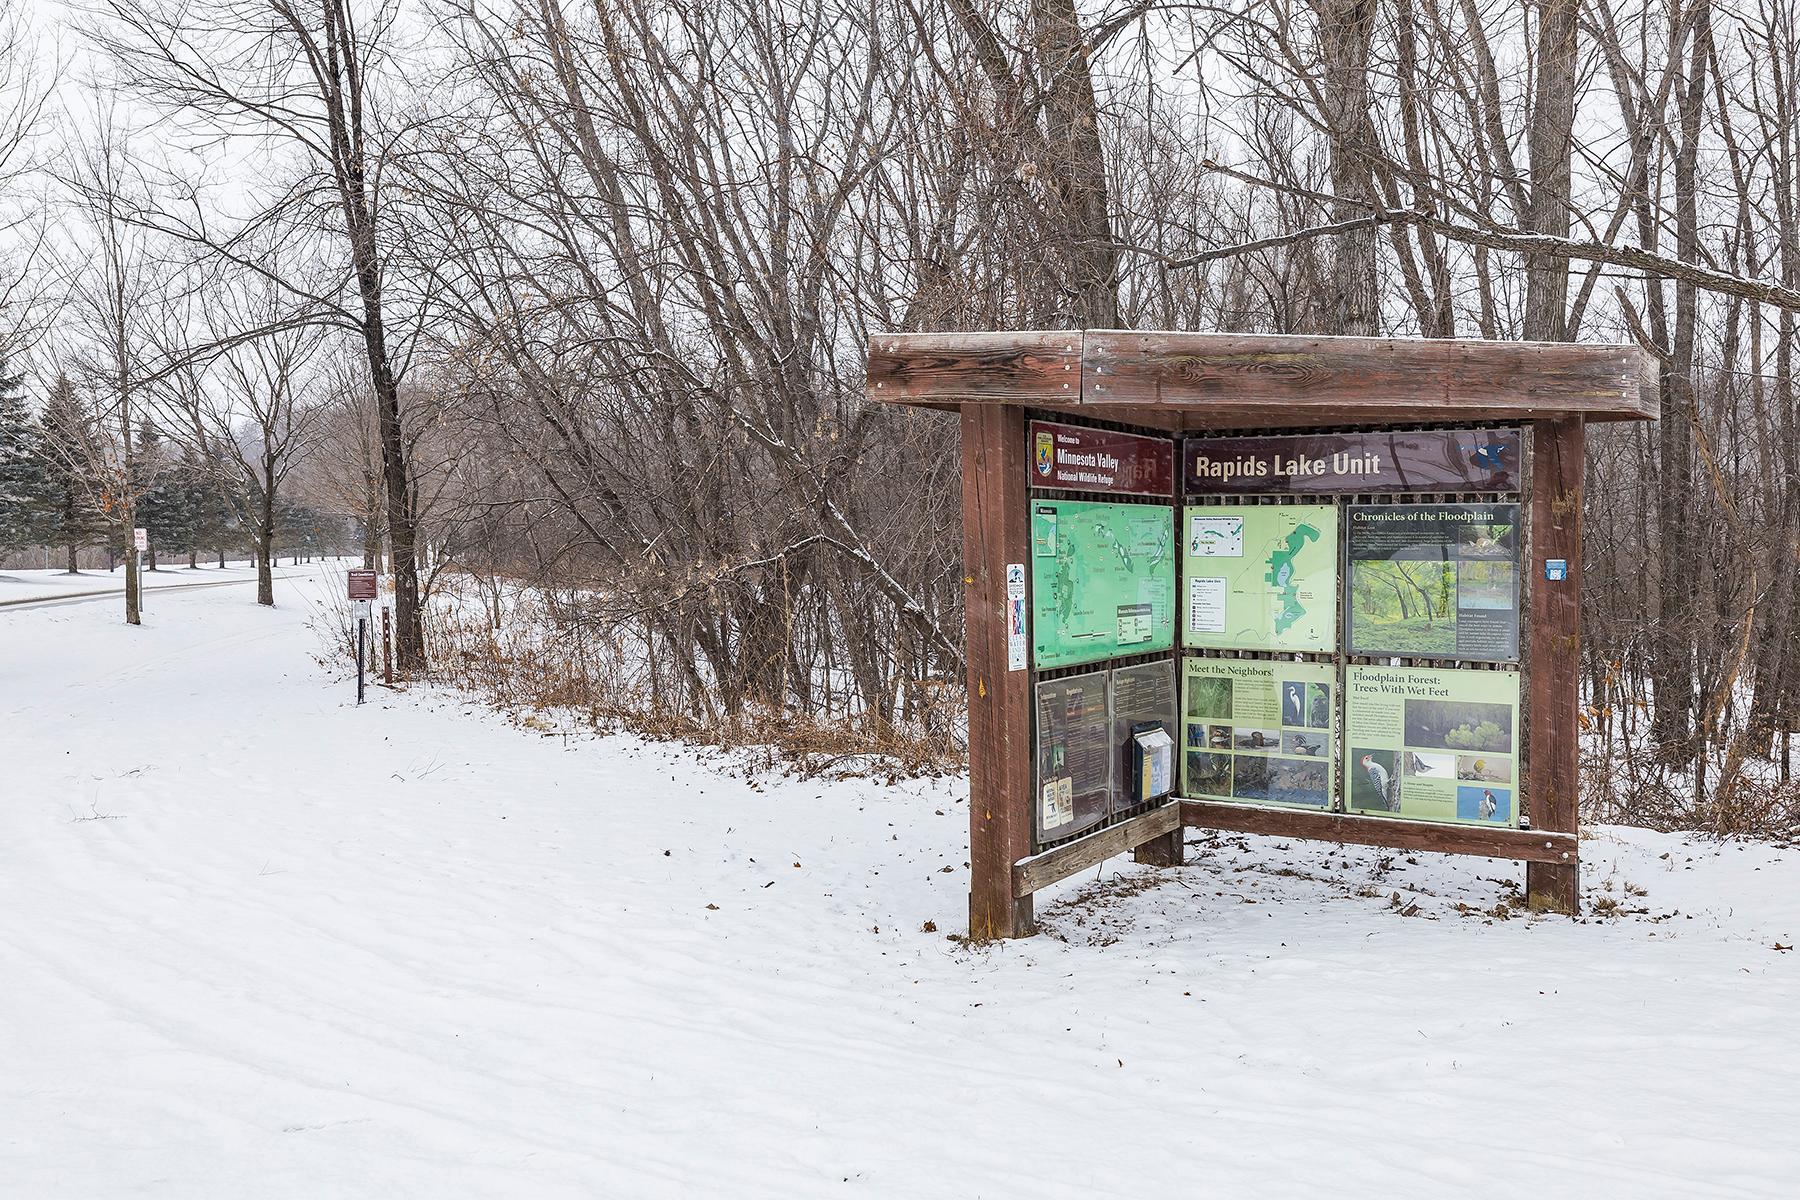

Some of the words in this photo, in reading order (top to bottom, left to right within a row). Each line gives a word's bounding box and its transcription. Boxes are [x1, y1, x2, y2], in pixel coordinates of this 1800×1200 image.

[1057, 434, 1075, 444] Welcome
[1075, 437, 1080, 445] to
[1057, 448, 1096, 467] Minnesota
[1096, 452, 1119, 473] Valley
[1196, 455, 1268, 482] Rapids
[1274, 454, 1326, 476] Lake
[1333, 452, 1381, 475] Unit
[1057, 470, 1079, 482] National
[1079, 472, 1098, 484] Wildlife
[1097, 473, 1114, 487] Refuge
[1353, 511, 1406, 521] Chronicles
[1407, 511, 1419, 521] of
[1420, 511, 1436, 521] the
[1439, 511, 1494, 524] Floodplain
[1188, 664, 1210, 673] Meet
[1211, 665, 1226, 674] the
[1227, 666, 1274, 678] Neighbors!
[1353, 671, 1405, 684] Floodplain
[1408, 674, 1441, 685] Forest:
[1353, 682, 1378, 693] Trees
[1380, 684, 1405, 694] With
[1407, 685, 1426, 695] Wet
[1429, 686, 1449, 697] Feet
